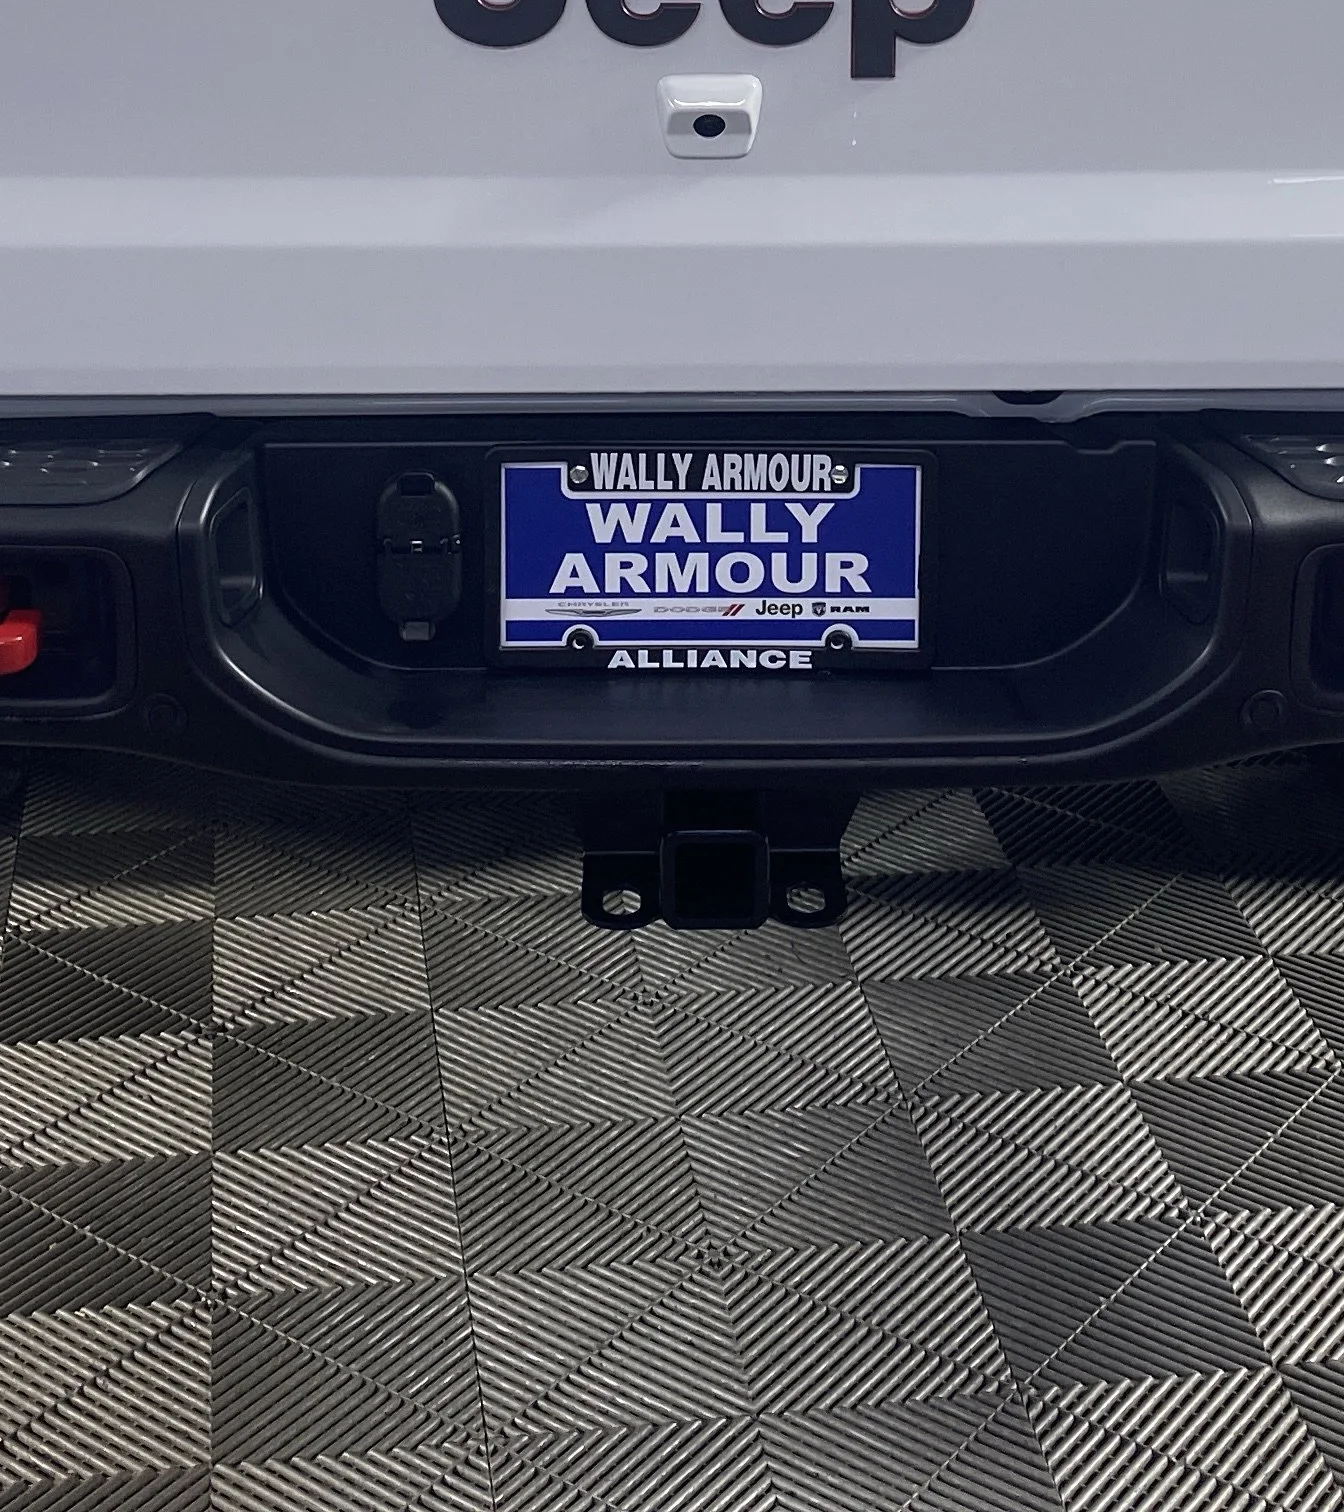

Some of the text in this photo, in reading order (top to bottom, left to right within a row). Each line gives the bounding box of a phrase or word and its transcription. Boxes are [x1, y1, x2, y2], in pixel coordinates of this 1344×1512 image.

[590, 452, 832, 492] WALLY ARMOUR
[585, 502, 836, 544] WALLY
[549, 552, 872, 594] ARMOUR
[755, 599, 804, 619] Jeep
[830, 605, 870, 614] RAM
[607, 649, 813, 670] ALLIANCE
